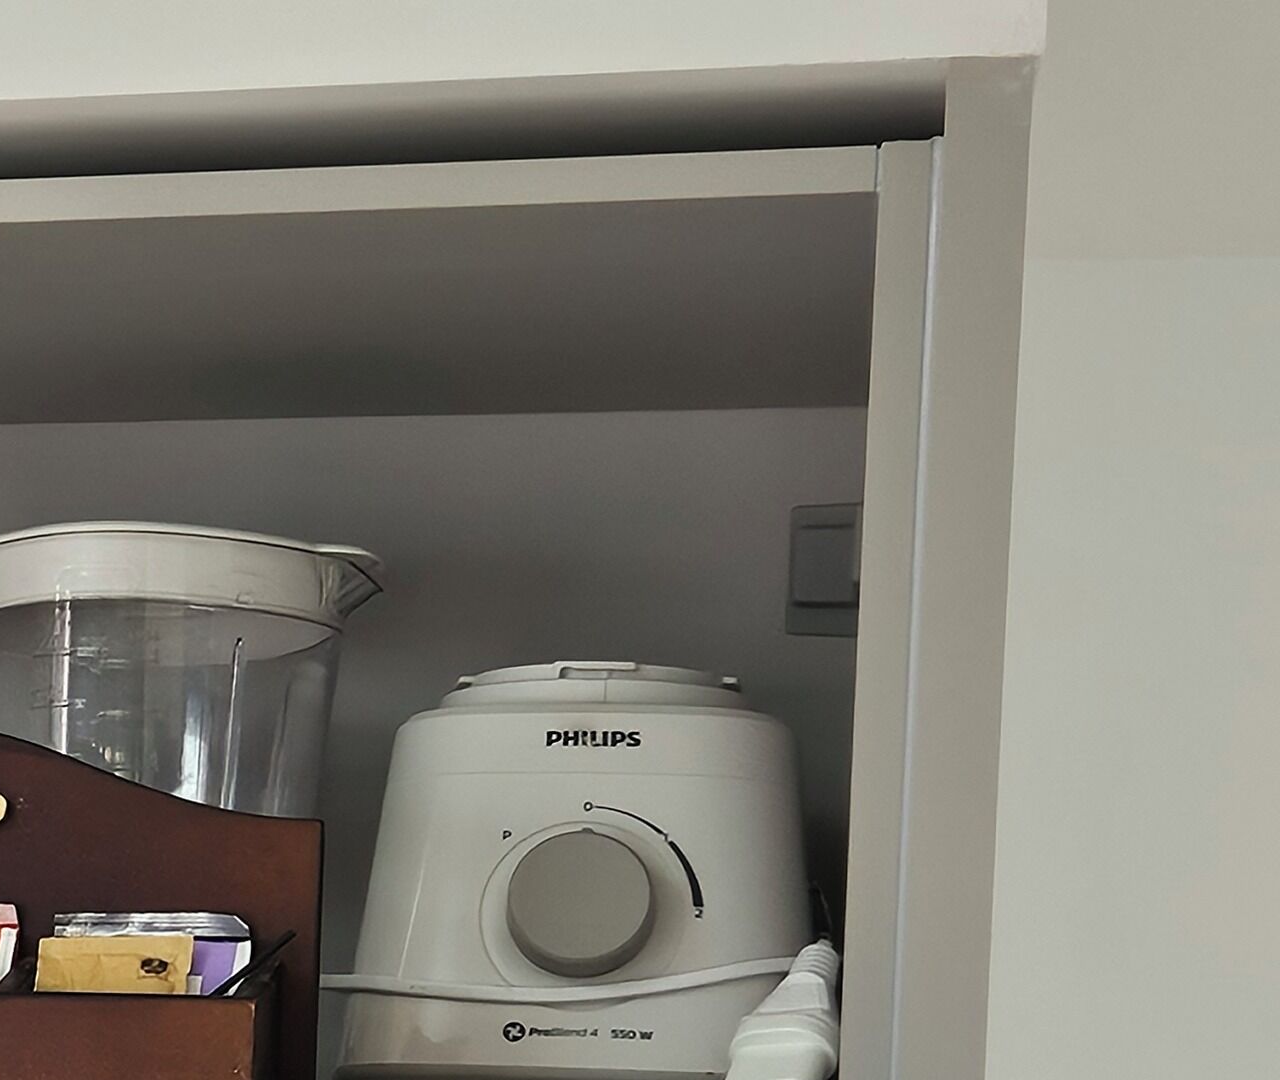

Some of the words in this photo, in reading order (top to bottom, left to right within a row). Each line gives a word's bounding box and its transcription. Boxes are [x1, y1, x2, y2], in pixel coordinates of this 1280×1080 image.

[546, 731, 642, 747] PHILIPS
[503, 830, 512, 840] P
[694, 908, 703, 919] 2
[589, 1028, 598, 1037] 4
[610, 1029, 637, 1040] 550
[639, 1031, 654, 1041] W
